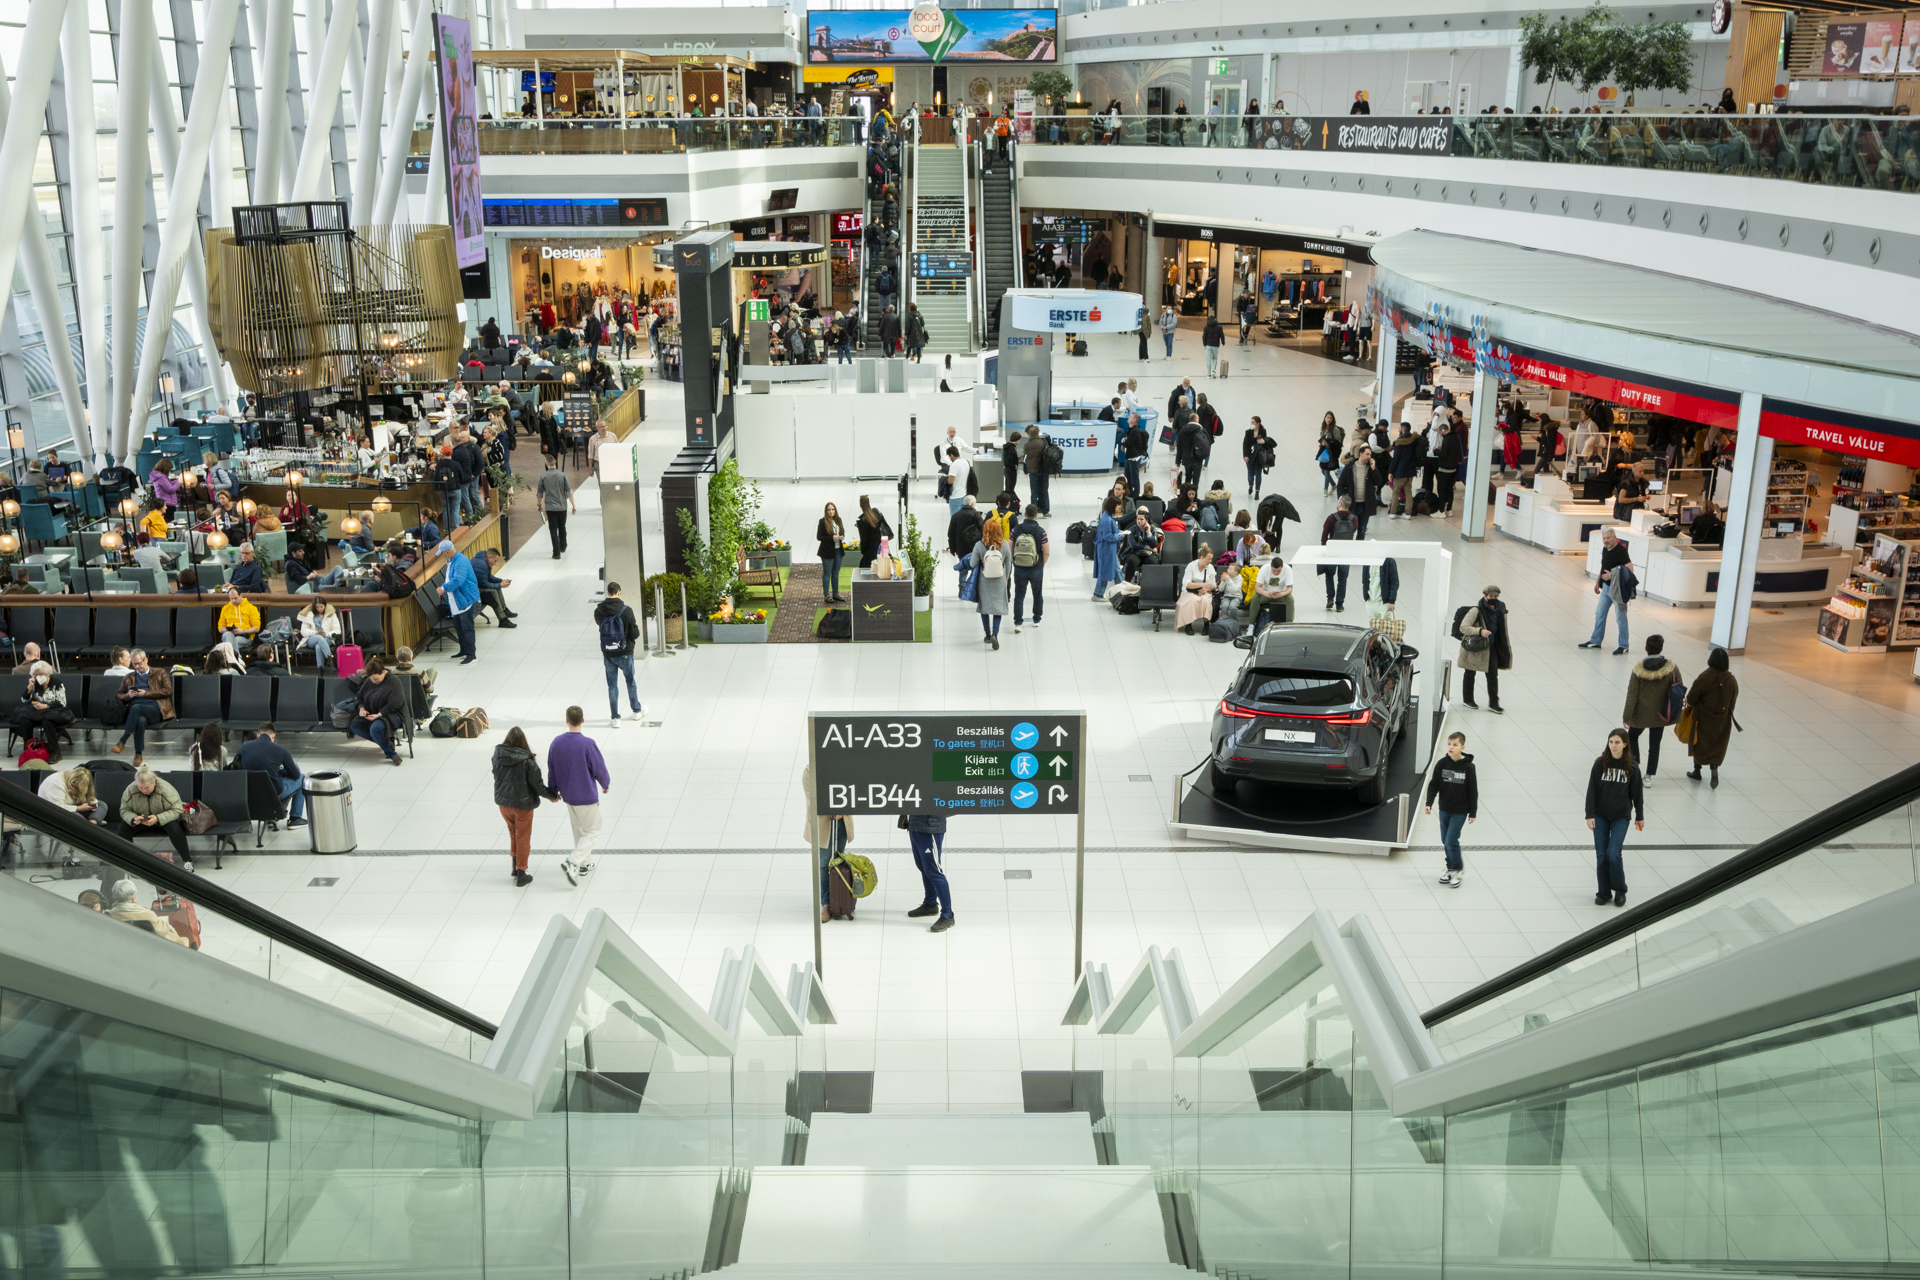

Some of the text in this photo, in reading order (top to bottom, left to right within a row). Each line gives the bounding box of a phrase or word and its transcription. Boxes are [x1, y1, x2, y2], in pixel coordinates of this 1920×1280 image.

[913, 11, 939, 22] food
[912, 23, 942, 33] court
[664, 42, 716, 55] LEROY
[997, 77, 1028, 85] PLAZA
[1338, 124, 1398, 150] RESTAURANTS
[751, 226, 767, 236] GUESS
[1201, 229, 1213, 237] BOSS
[1304, 241, 1345, 254] TOMMY HILFIGER
[685, 258, 701, 266] bud
[1049, 309, 1087, 321] ERSTE
[1049, 321, 1065, 329] Bank
[1007, 337, 1033, 345] ERSTE
[1527, 364, 1567, 383] TRAVEL VALUE
[1621, 388, 1661, 406] DUTY FREE
[1806, 427, 1885, 452] TRAVEL VALUE
[868, 612, 888, 620] bud
[821, 723, 922, 748] A1-A33
[956, 726, 1005, 736] Beszállás
[1283, 732, 1296, 740] NX
[933, 739, 946, 748] To
[947, 739, 976, 749] gates
[965, 755, 998, 766] Kijárat
[965, 766, 1005, 776] Exit 出口
[956, 785, 1005, 795] Beszállás
[828, 784, 922, 808] B1-B44
[933, 798, 946, 807] To
[947, 798, 976, 808] gates
